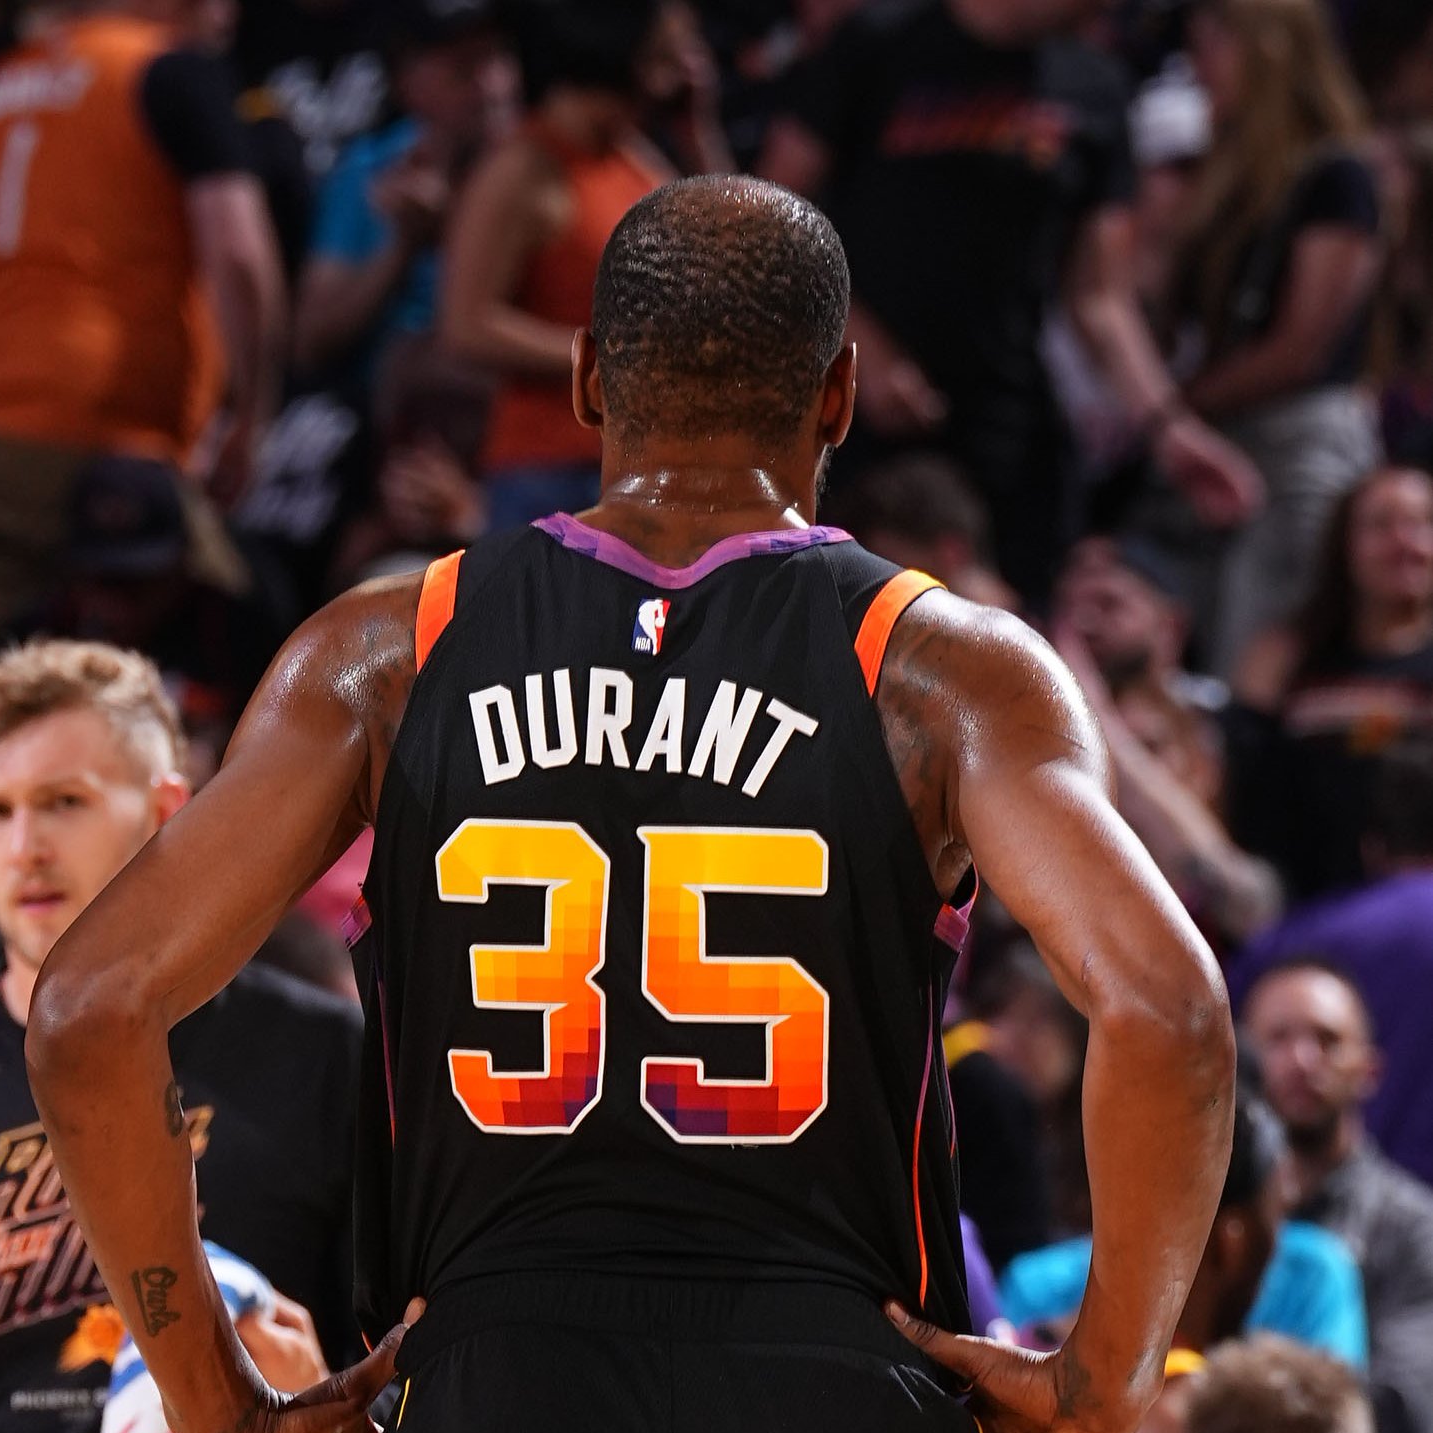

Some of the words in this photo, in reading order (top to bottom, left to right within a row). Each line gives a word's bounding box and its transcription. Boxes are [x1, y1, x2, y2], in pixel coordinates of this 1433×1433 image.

[634, 636, 651, 652] NBA
[468, 665, 819, 799] DURANT
[434, 817, 830, 1145] 35
